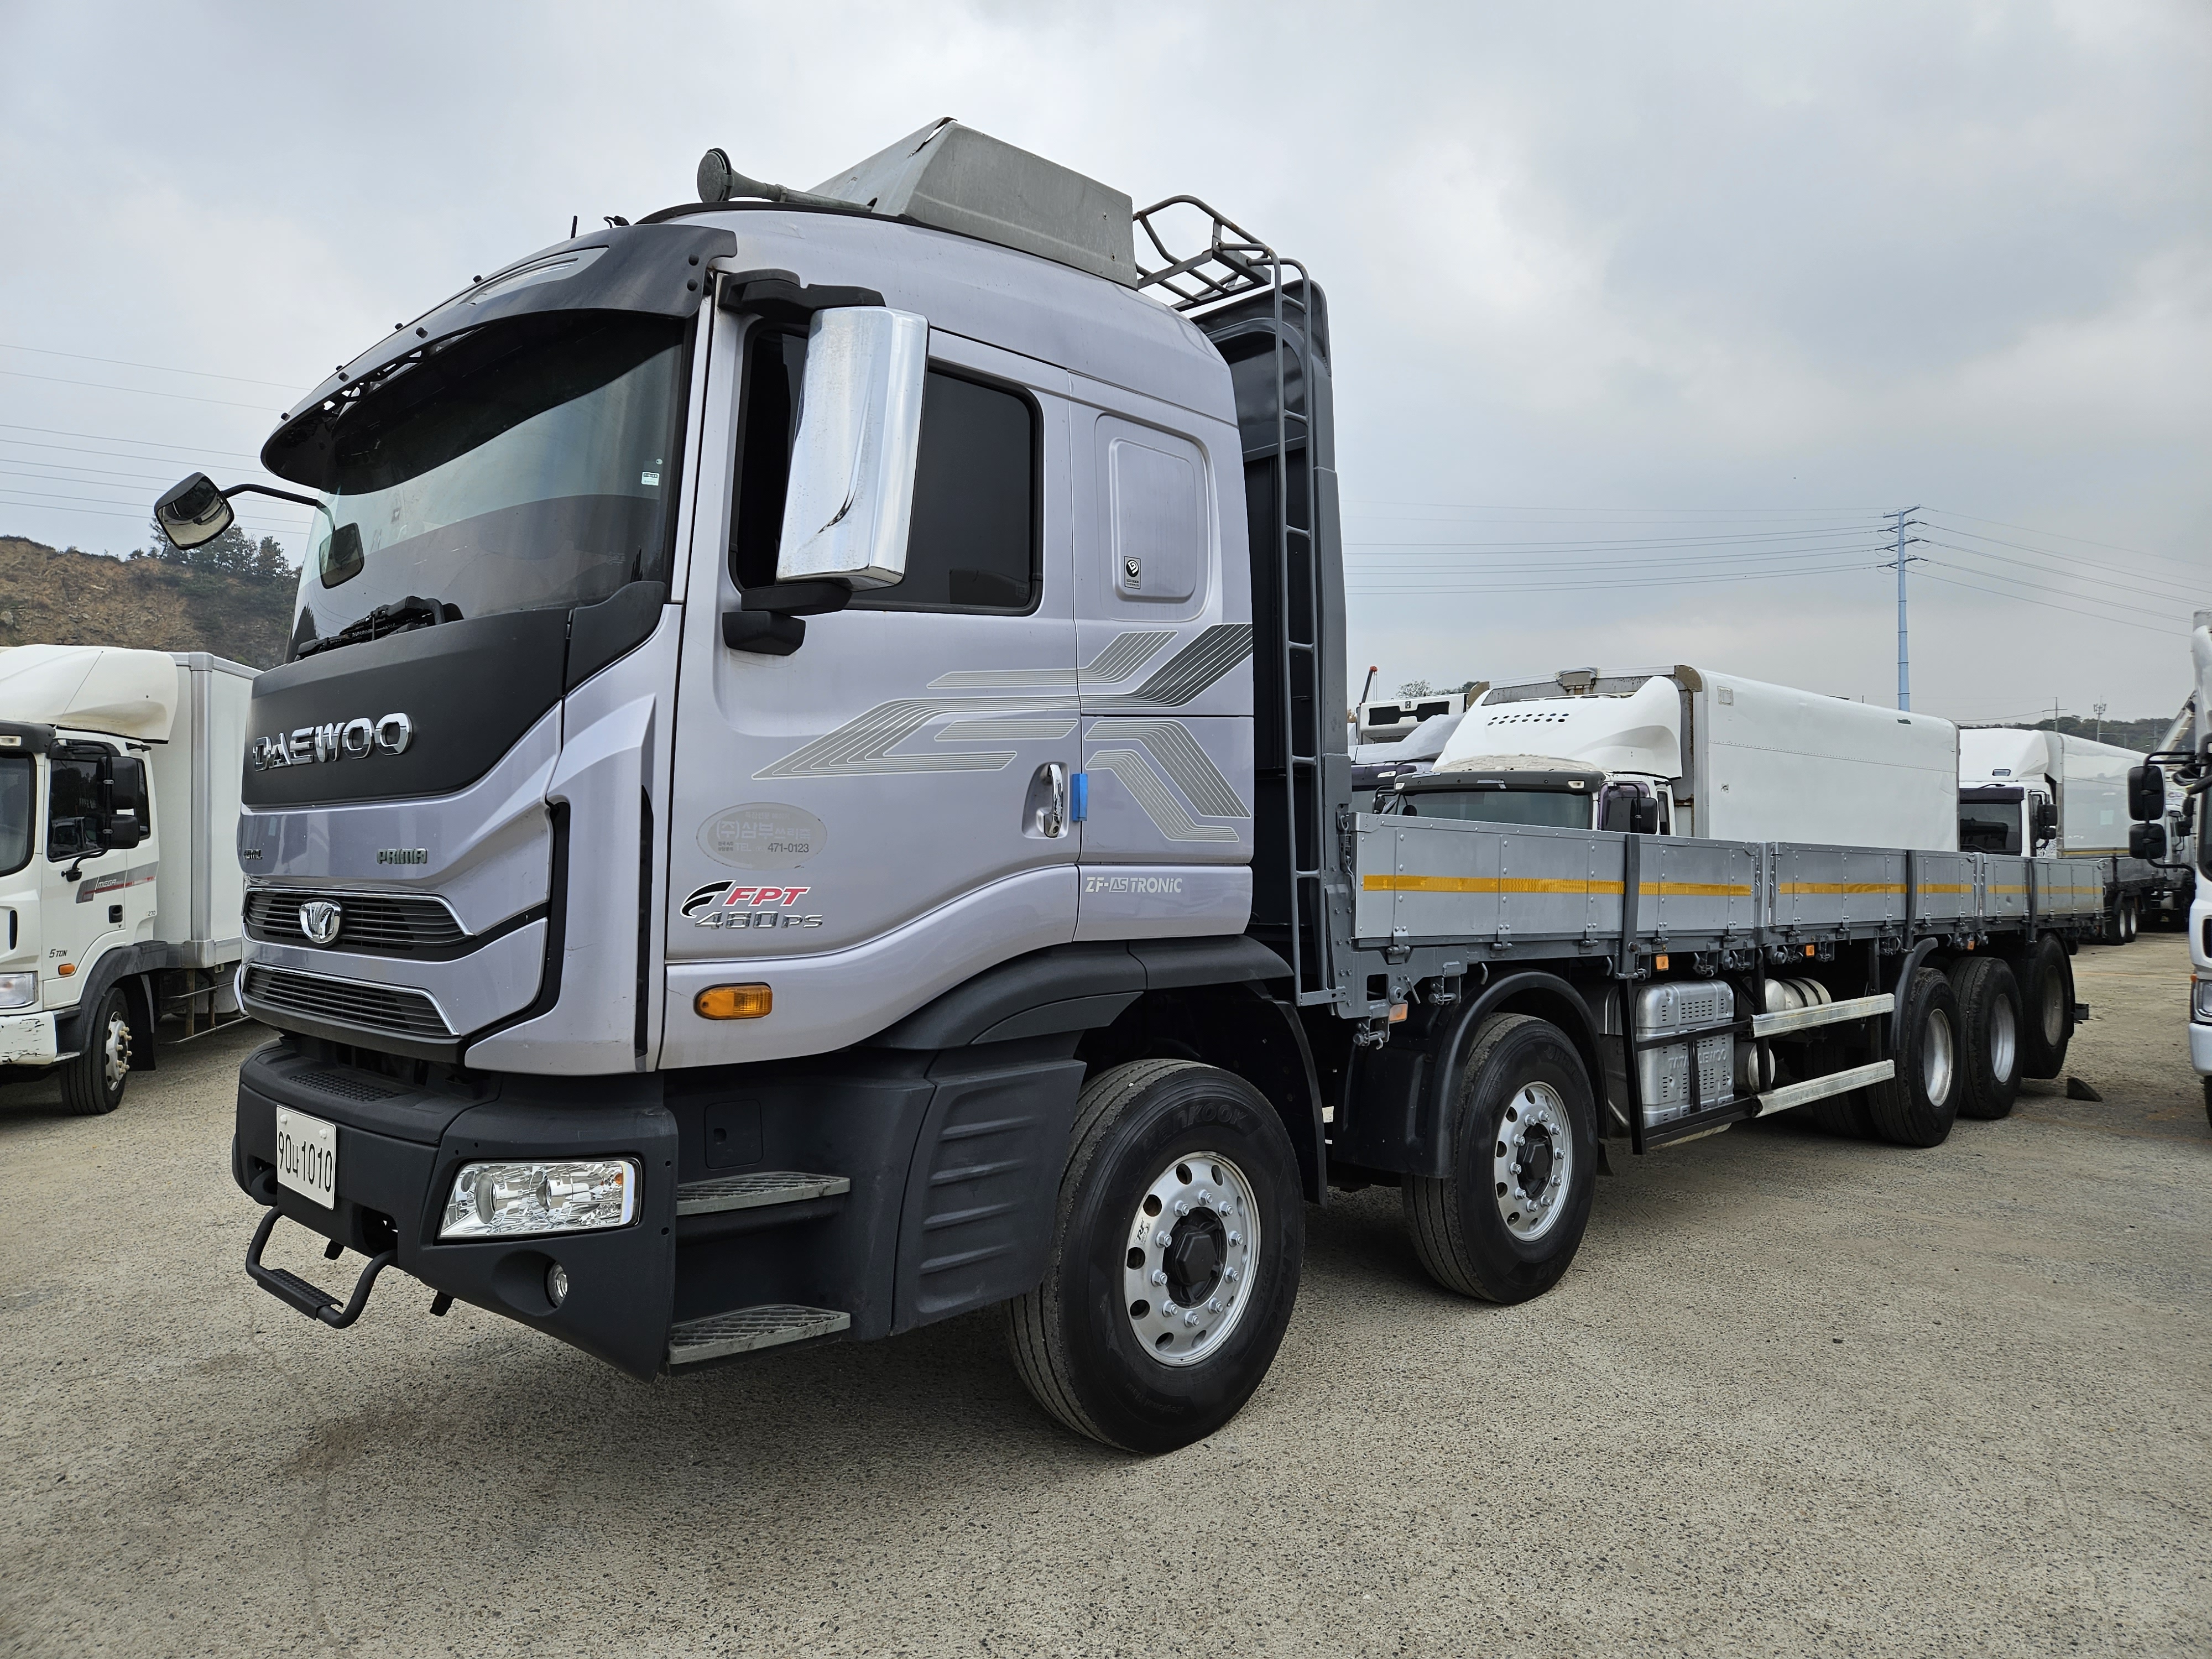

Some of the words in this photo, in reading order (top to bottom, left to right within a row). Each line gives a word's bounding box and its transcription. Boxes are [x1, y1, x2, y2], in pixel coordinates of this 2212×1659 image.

[253, 712, 413, 771] DAEWOO
[377, 848, 427, 864] PRIMA
[767, 843, 810, 853] 471-0123
[97, 879, 117, 889] MEGA
[722, 886, 811, 906] FPT
[49, 948, 56, 958] 5
[56, 948, 68, 958] TON
[1698, 1048, 1726, 1064] AEWOO
